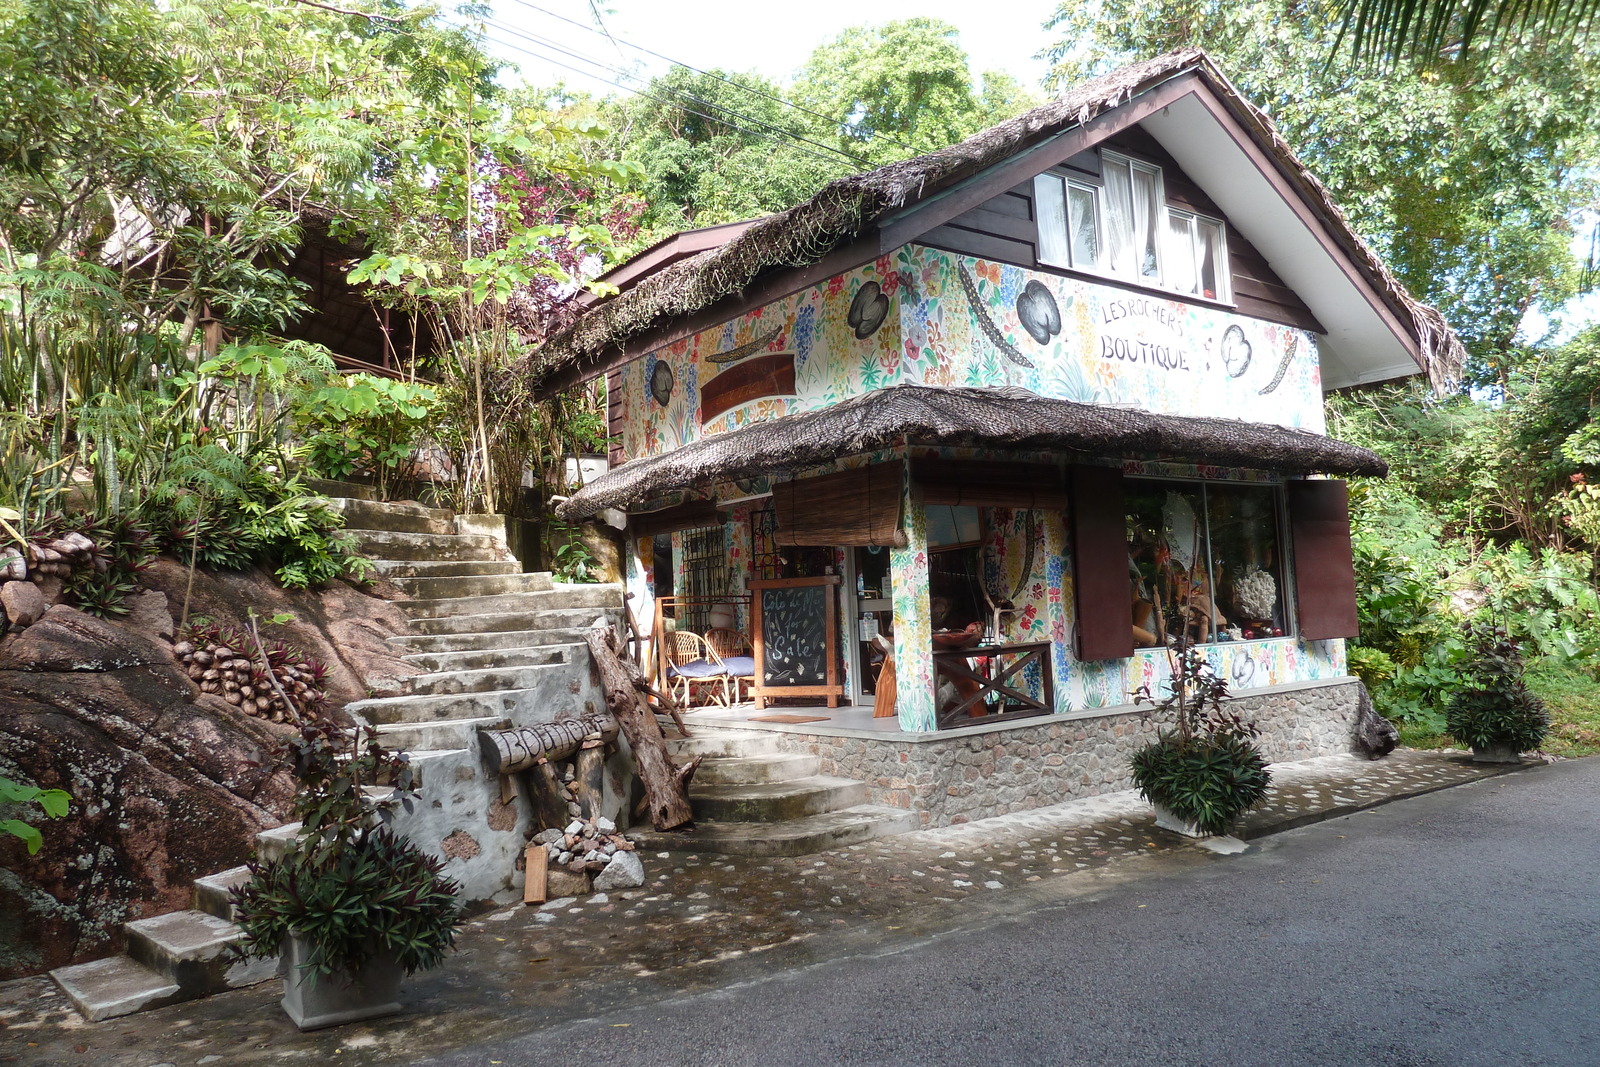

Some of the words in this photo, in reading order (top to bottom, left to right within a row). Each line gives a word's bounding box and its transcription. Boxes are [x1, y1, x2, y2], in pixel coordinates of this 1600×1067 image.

[1100, 334, 1190, 372] BOUTIQUE
[784, 612, 803, 639] for
[772, 636, 813, 661] Sale
